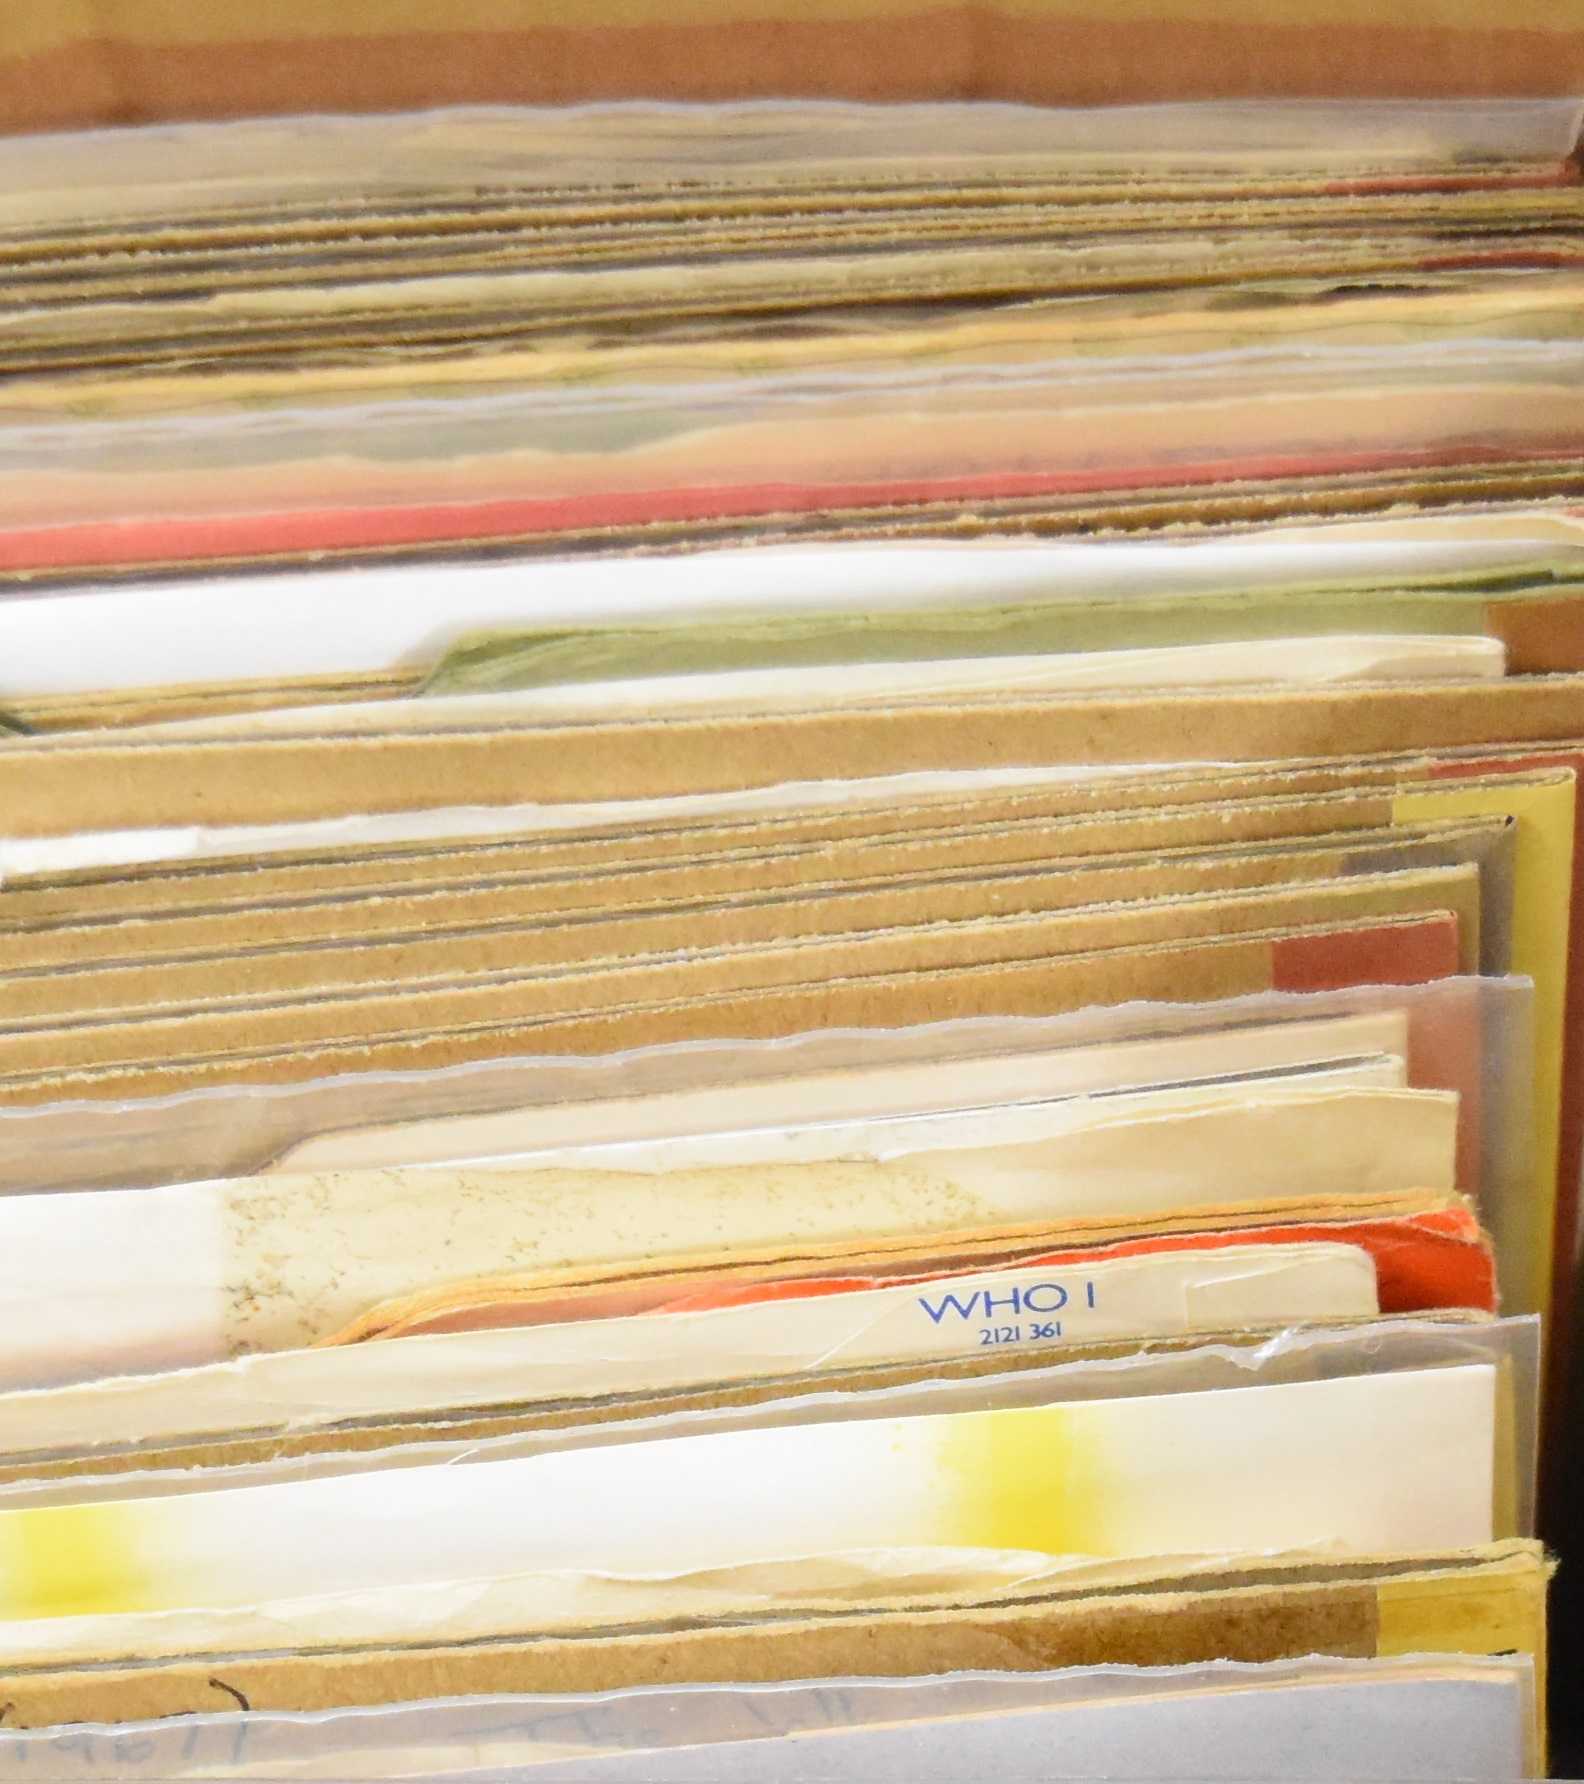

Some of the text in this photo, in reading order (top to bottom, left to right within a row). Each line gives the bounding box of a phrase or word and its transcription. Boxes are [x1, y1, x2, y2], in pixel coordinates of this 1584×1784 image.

[917, 1282, 1069, 1326] WHO
[979, 1321, 1062, 1346] 2121 361
